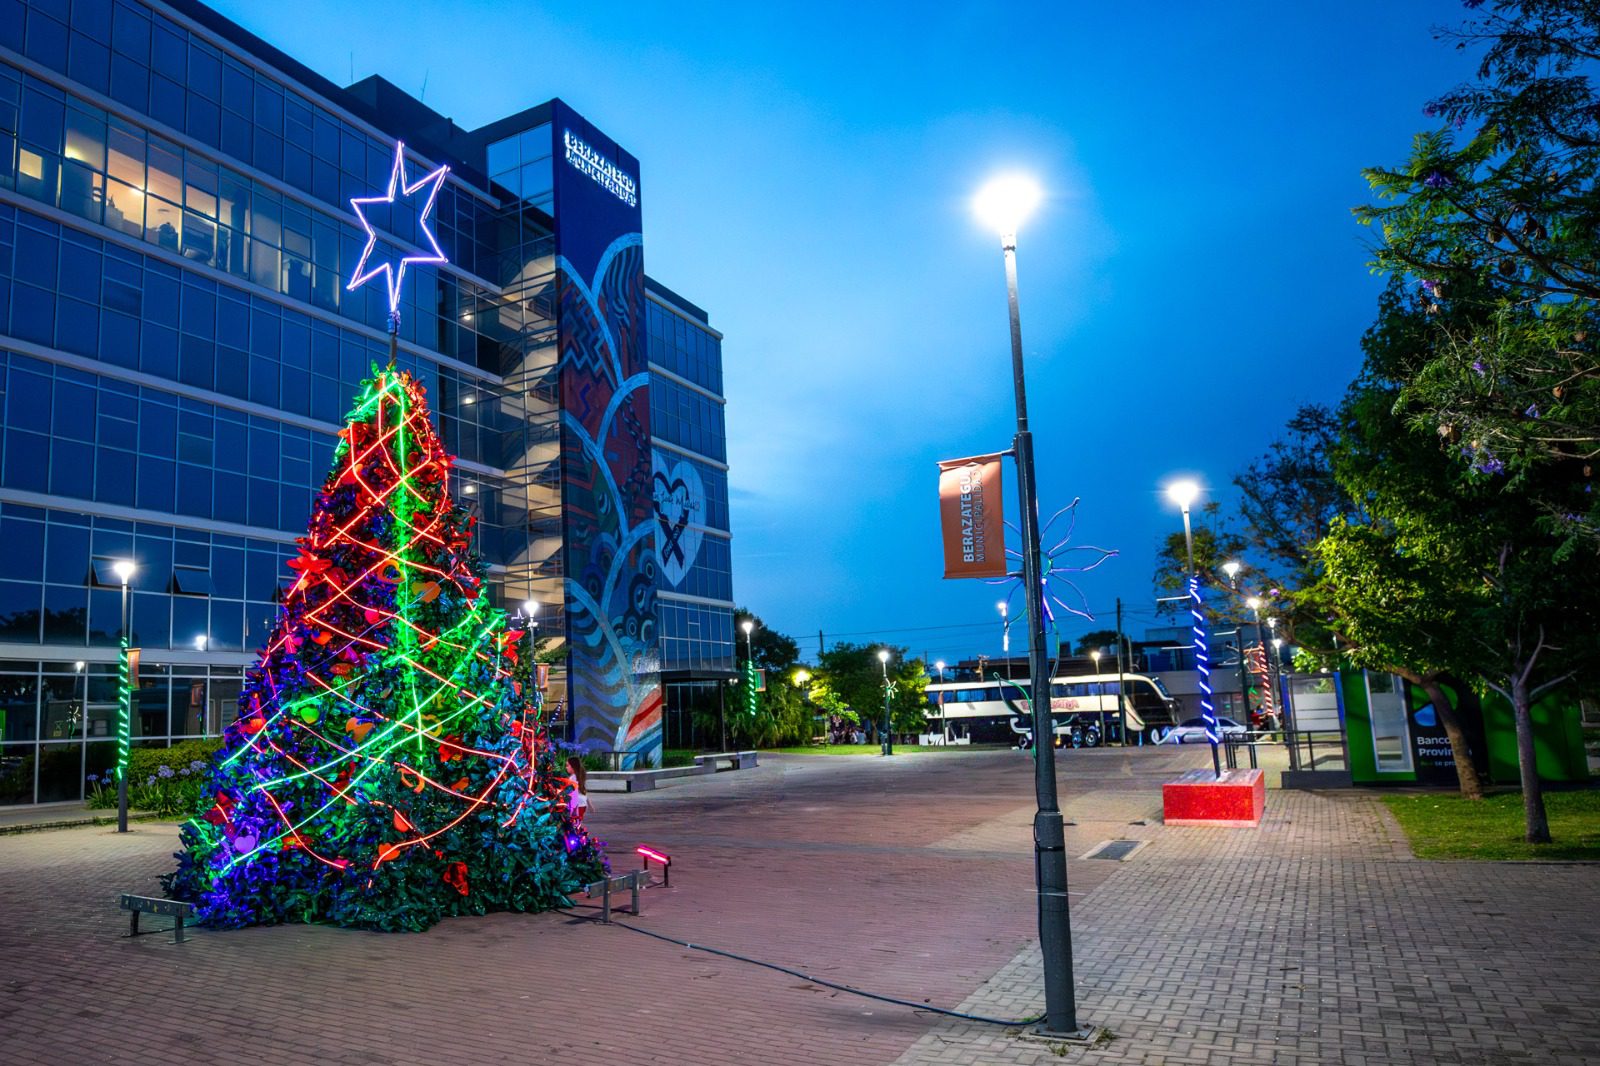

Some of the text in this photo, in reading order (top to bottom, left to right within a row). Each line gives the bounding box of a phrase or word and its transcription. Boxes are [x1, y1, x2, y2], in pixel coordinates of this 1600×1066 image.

[565, 130, 637, 194] BERAZATEGU
[973, 469, 985, 562] MUNICIPALIDAD
[1417, 736, 1451, 745] Banco
